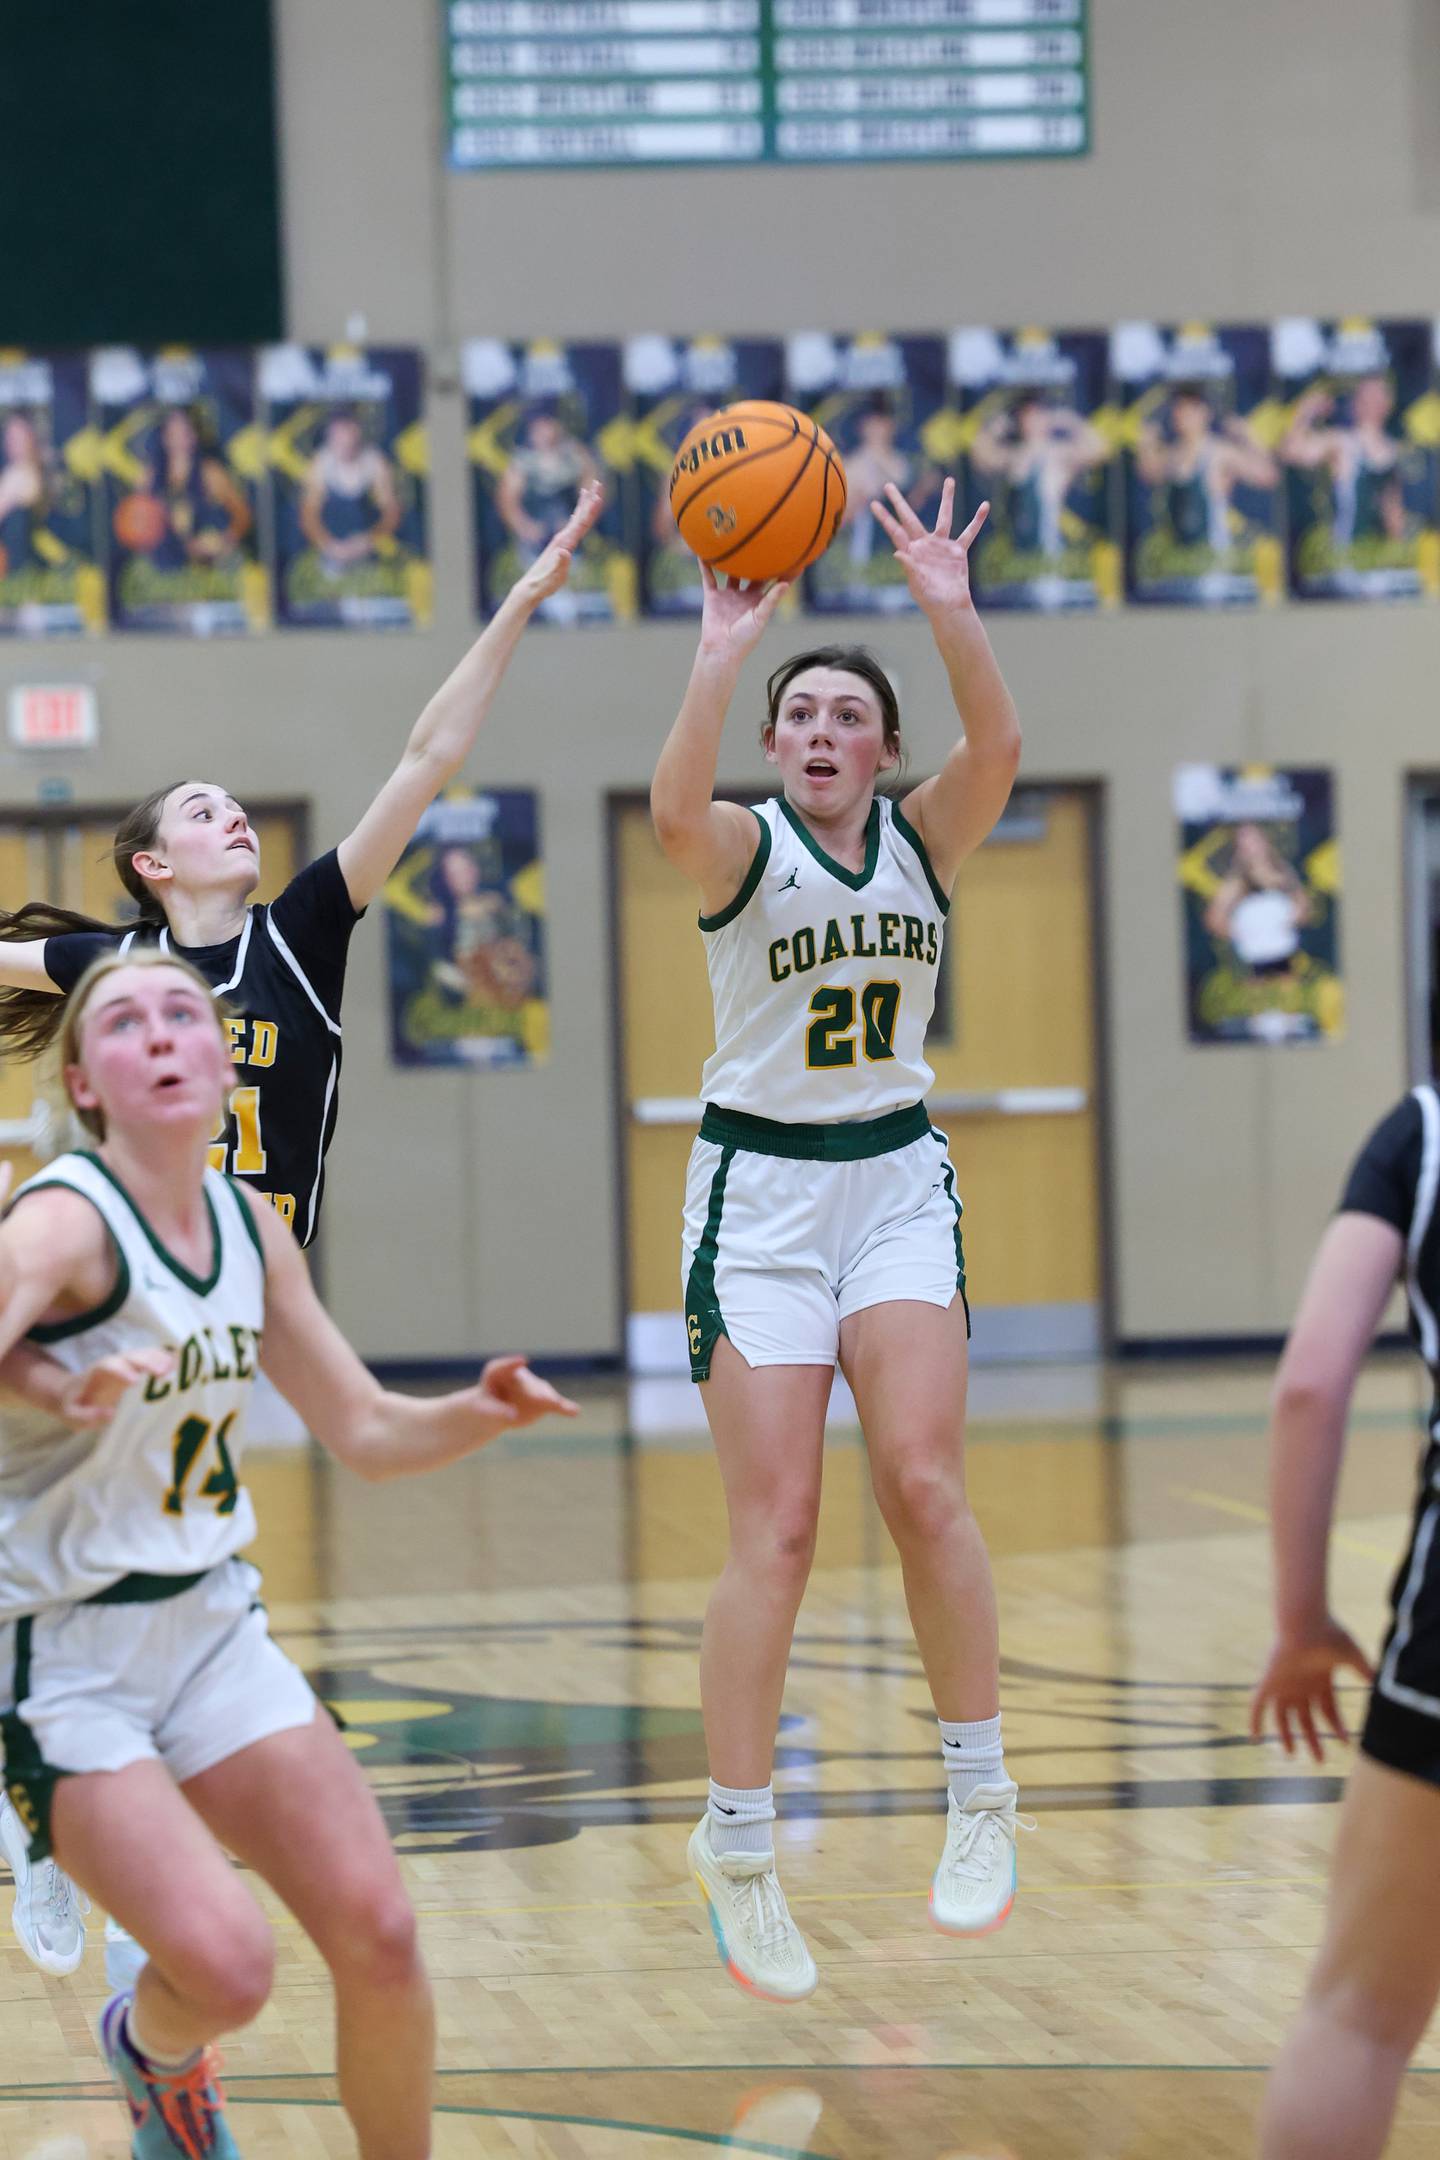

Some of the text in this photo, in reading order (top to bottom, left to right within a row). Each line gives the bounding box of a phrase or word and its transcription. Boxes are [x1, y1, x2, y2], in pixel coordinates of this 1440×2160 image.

[769, 912, 938, 983] COALERS
[223, 1018, 279, 1067] ED
[805, 979, 902, 1071] 20
